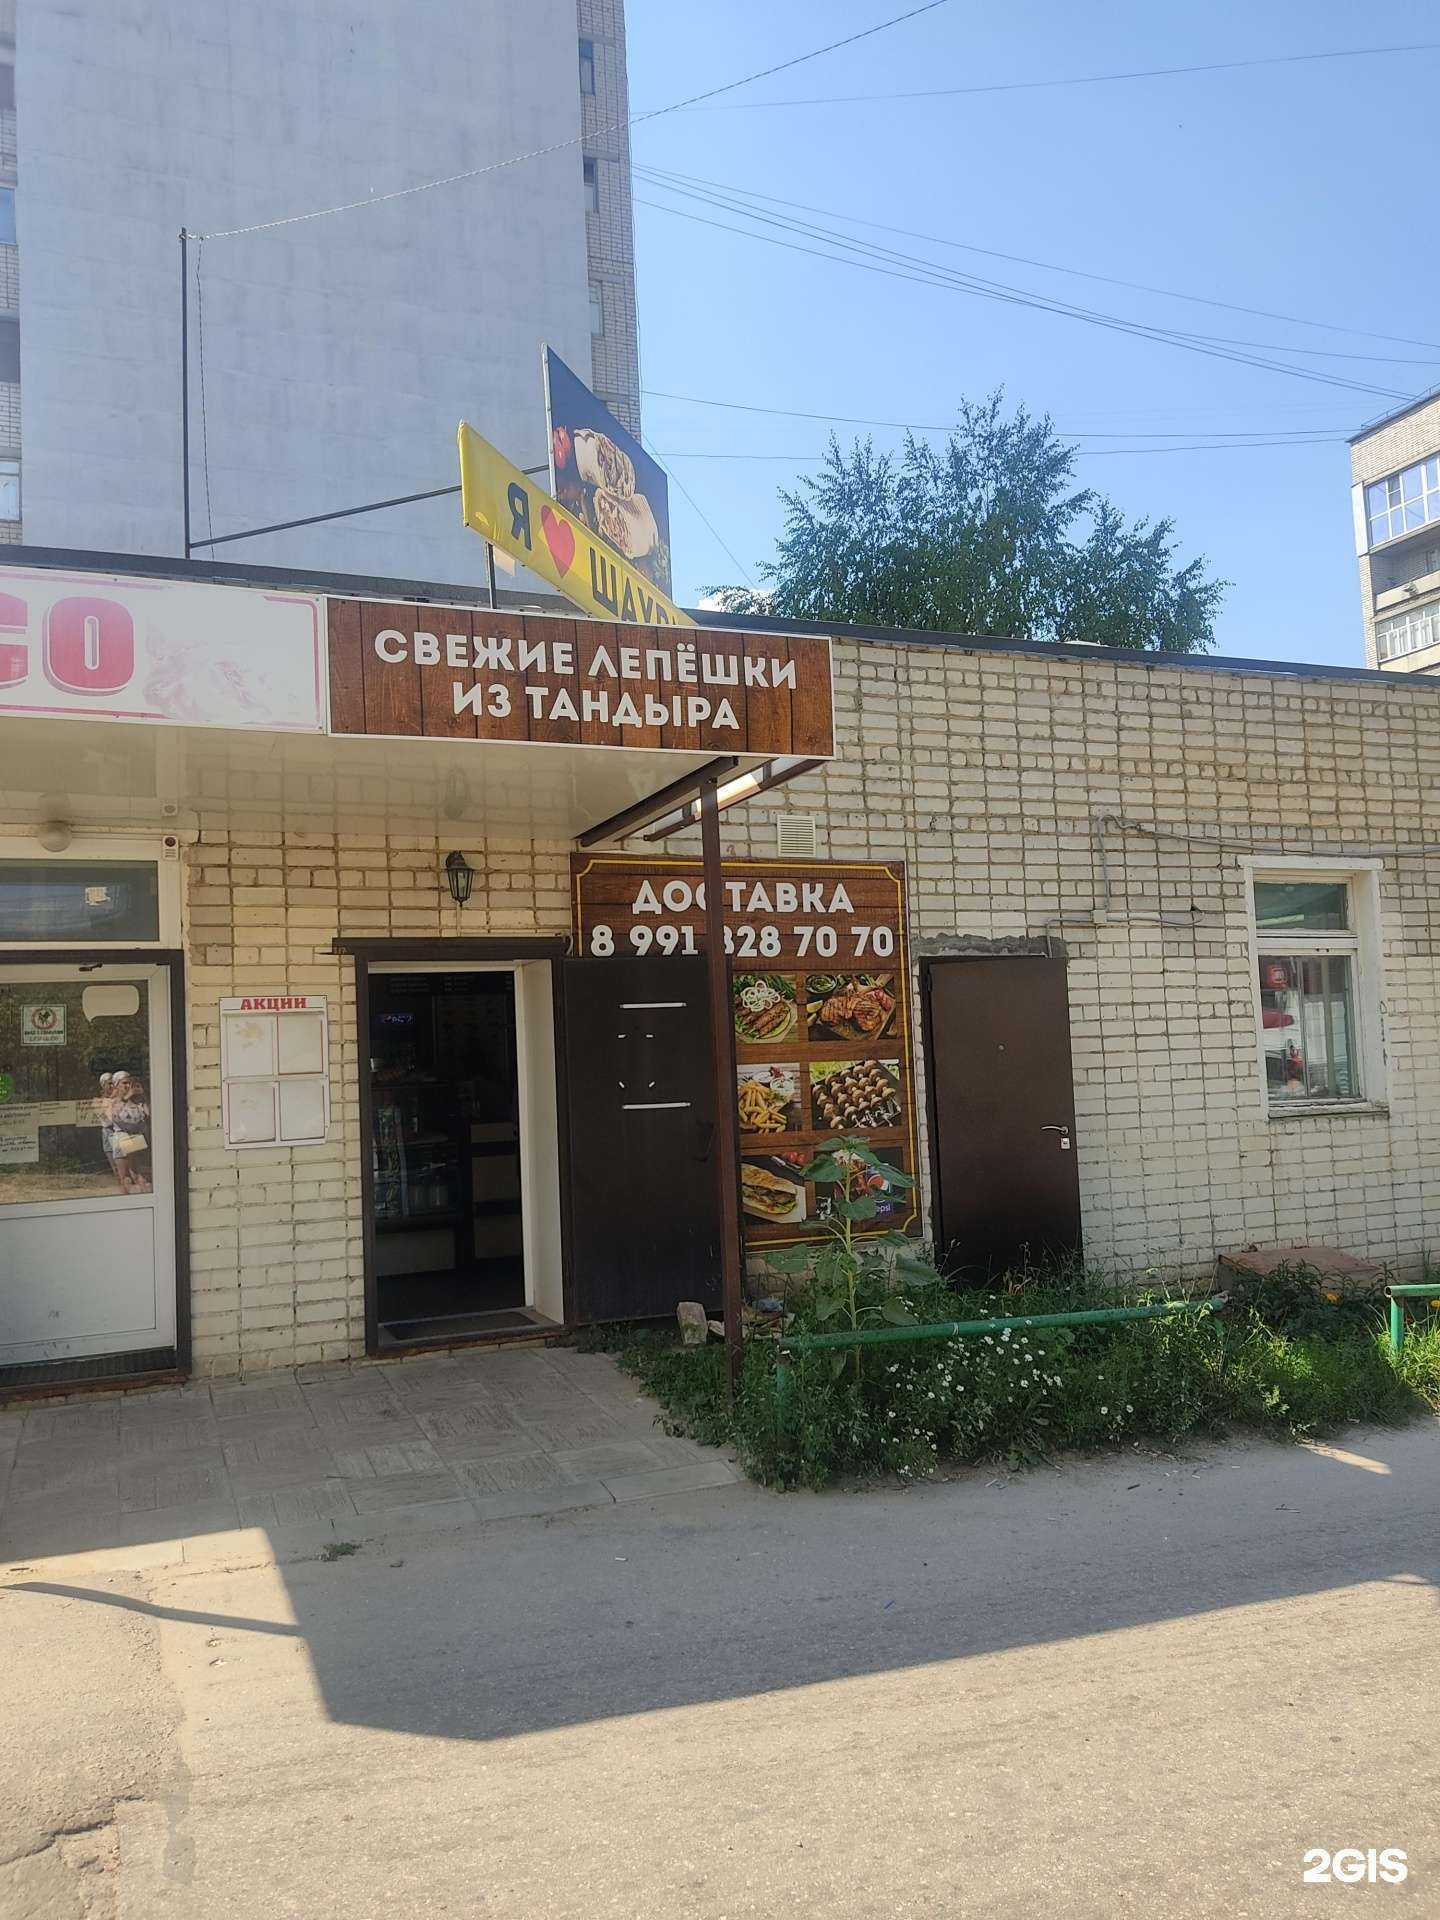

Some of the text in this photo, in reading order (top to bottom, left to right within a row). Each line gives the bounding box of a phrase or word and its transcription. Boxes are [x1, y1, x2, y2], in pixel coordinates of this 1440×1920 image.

[507, 482, 676, 624] Я ШАУР
[374, 629, 797, 690] СВЕЖИЕ ЛЕПЁШКИ
[453, 681, 740, 730] ИЗ ТАНДЫРА
[590, 924, 615, 957] 8
[629, 925, 699, 956] 991
[793, 926, 838, 958] 70
[851, 926, 894, 957] 70
[240, 997, 307, 1011] АКЦИИ
